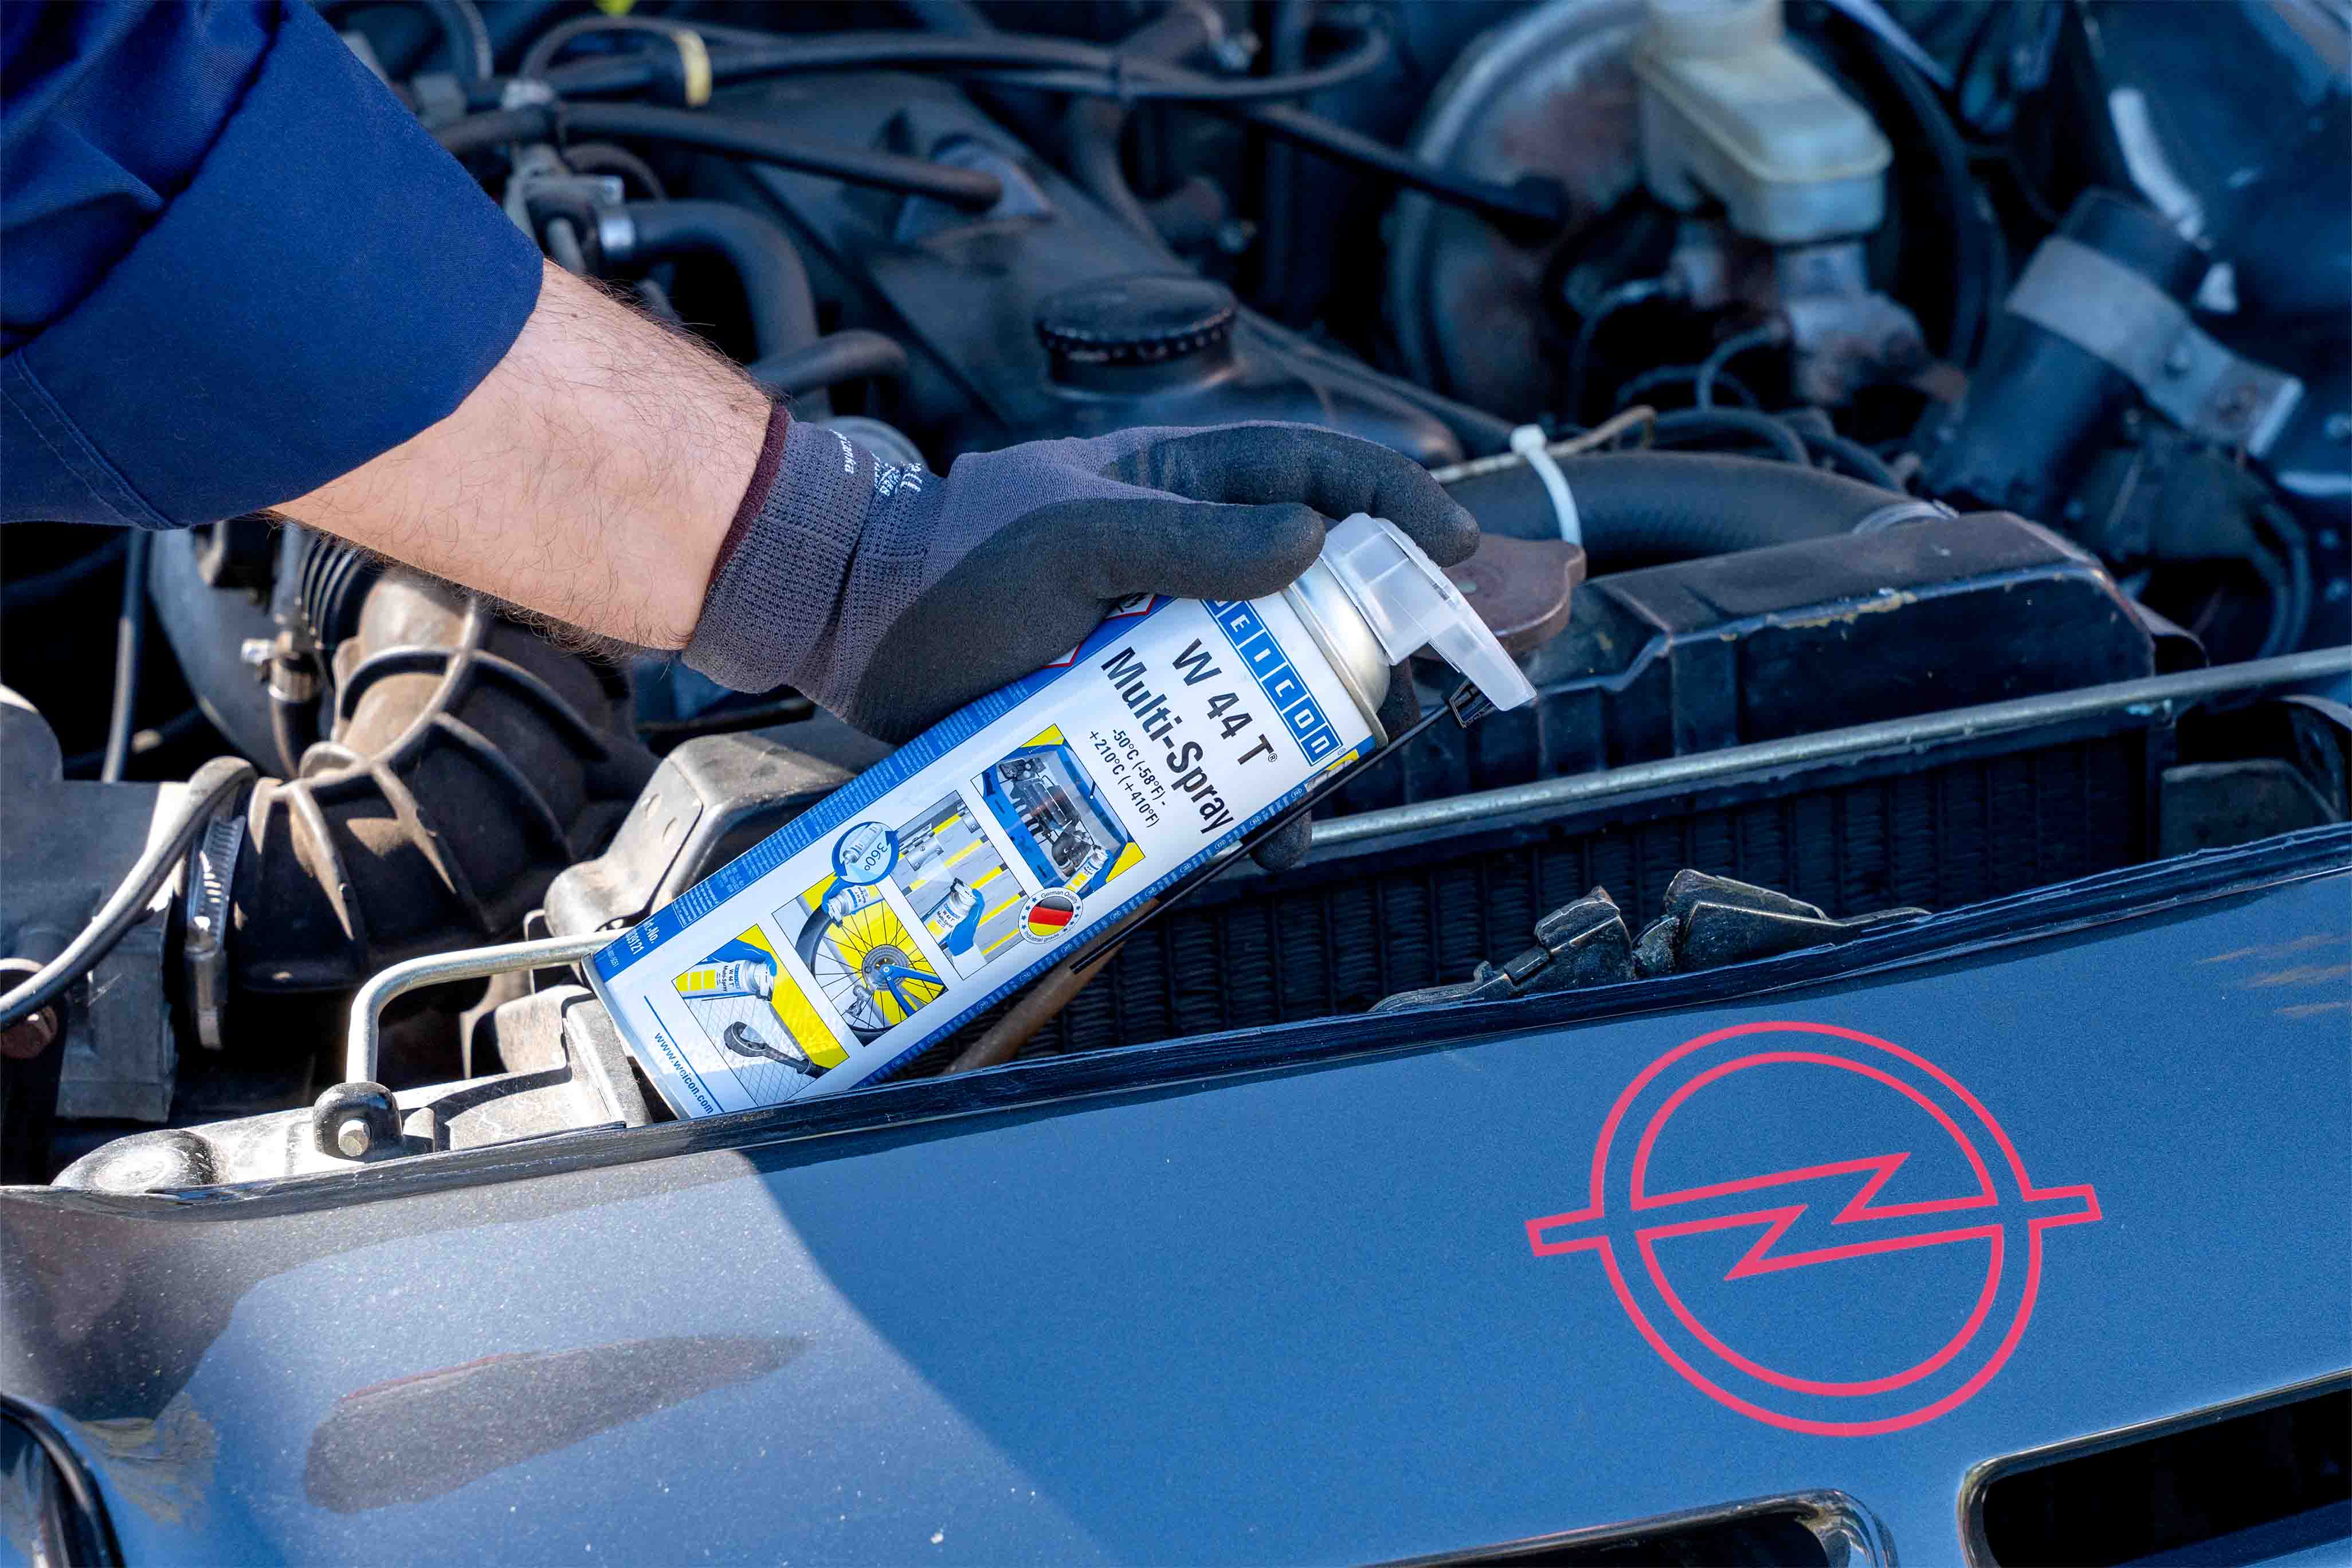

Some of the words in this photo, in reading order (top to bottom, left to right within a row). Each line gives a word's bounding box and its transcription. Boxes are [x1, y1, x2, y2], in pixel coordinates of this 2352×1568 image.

[1172, 637, 1222, 686] W
[1207, 692, 1253, 740] 44
[1212, 601, 1330, 754] EICON
[1089, 731, 1125, 775] +210°C
[1118, 775, 1160, 828] (+410°F)
[1101, 646, 1234, 834] Multi-Spray
[1113, 729, 1139, 760] -50°C
[1132, 761, 1166, 801] (-58°F)
[864, 842, 888, 871] 360°
[1041, 890, 1064, 899] German
[1064, 891, 1078, 904] Quality
[654, 1032, 714, 1114] www.weicon.com
